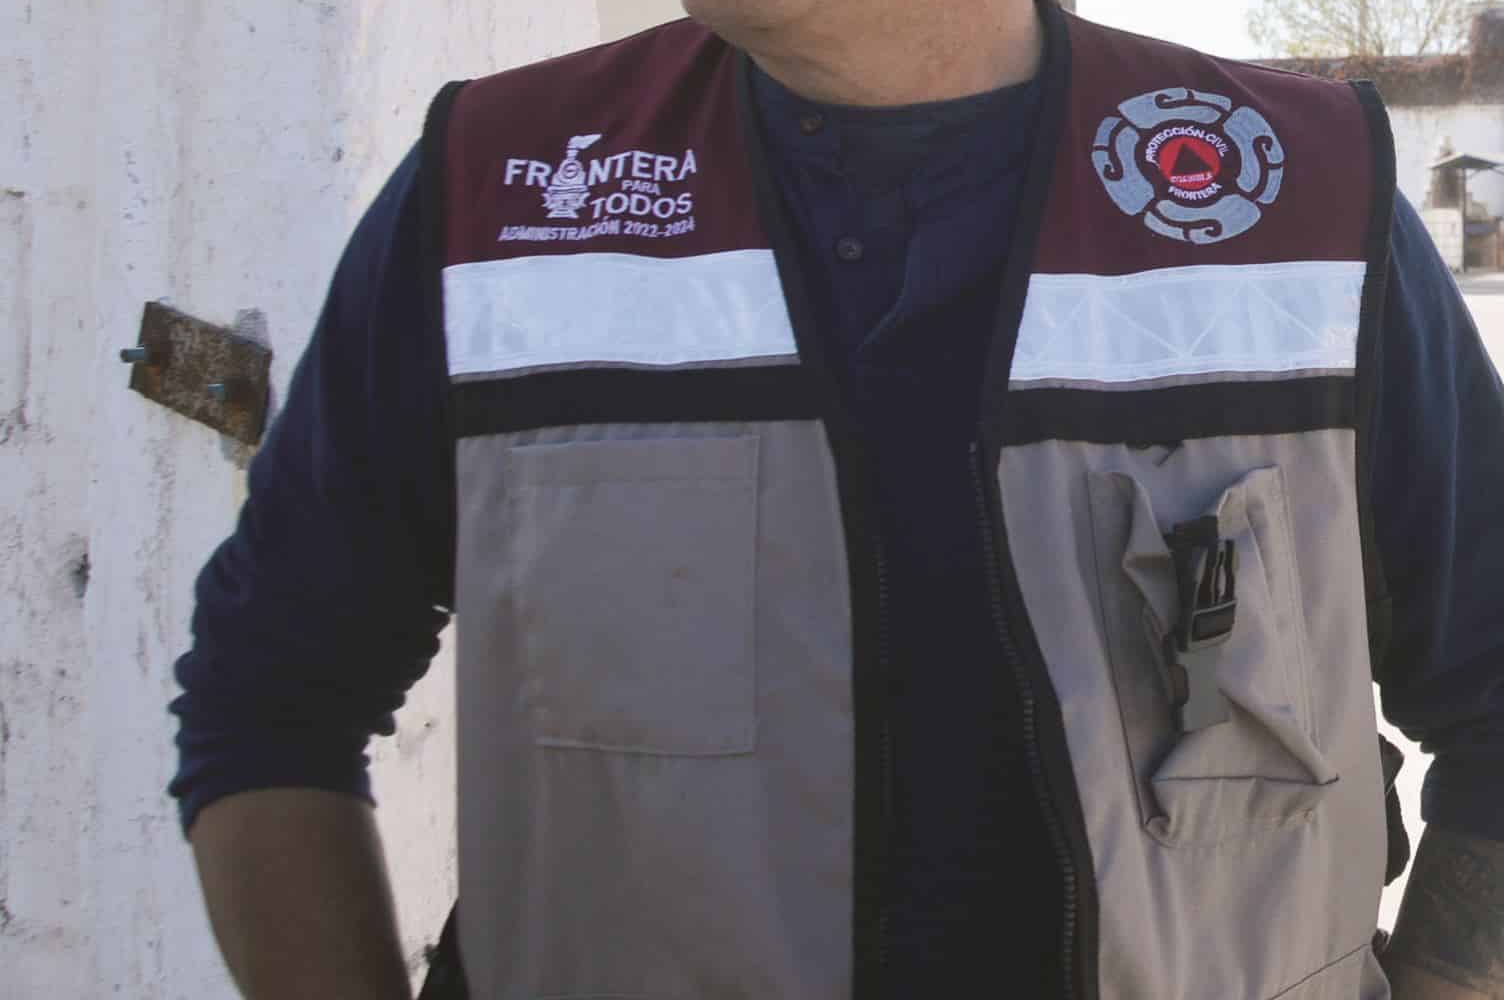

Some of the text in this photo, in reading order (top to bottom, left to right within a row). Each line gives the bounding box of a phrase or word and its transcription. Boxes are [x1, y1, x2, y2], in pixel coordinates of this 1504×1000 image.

[1145, 126, 1229, 163] PROTECCIÓN CIVIL
[622, 180, 661, 196] PARA
[1168, 183, 1222, 200] FRONTERA
[590, 193, 692, 219] TODOS
[623, 216, 695, 237] 2022-2024
